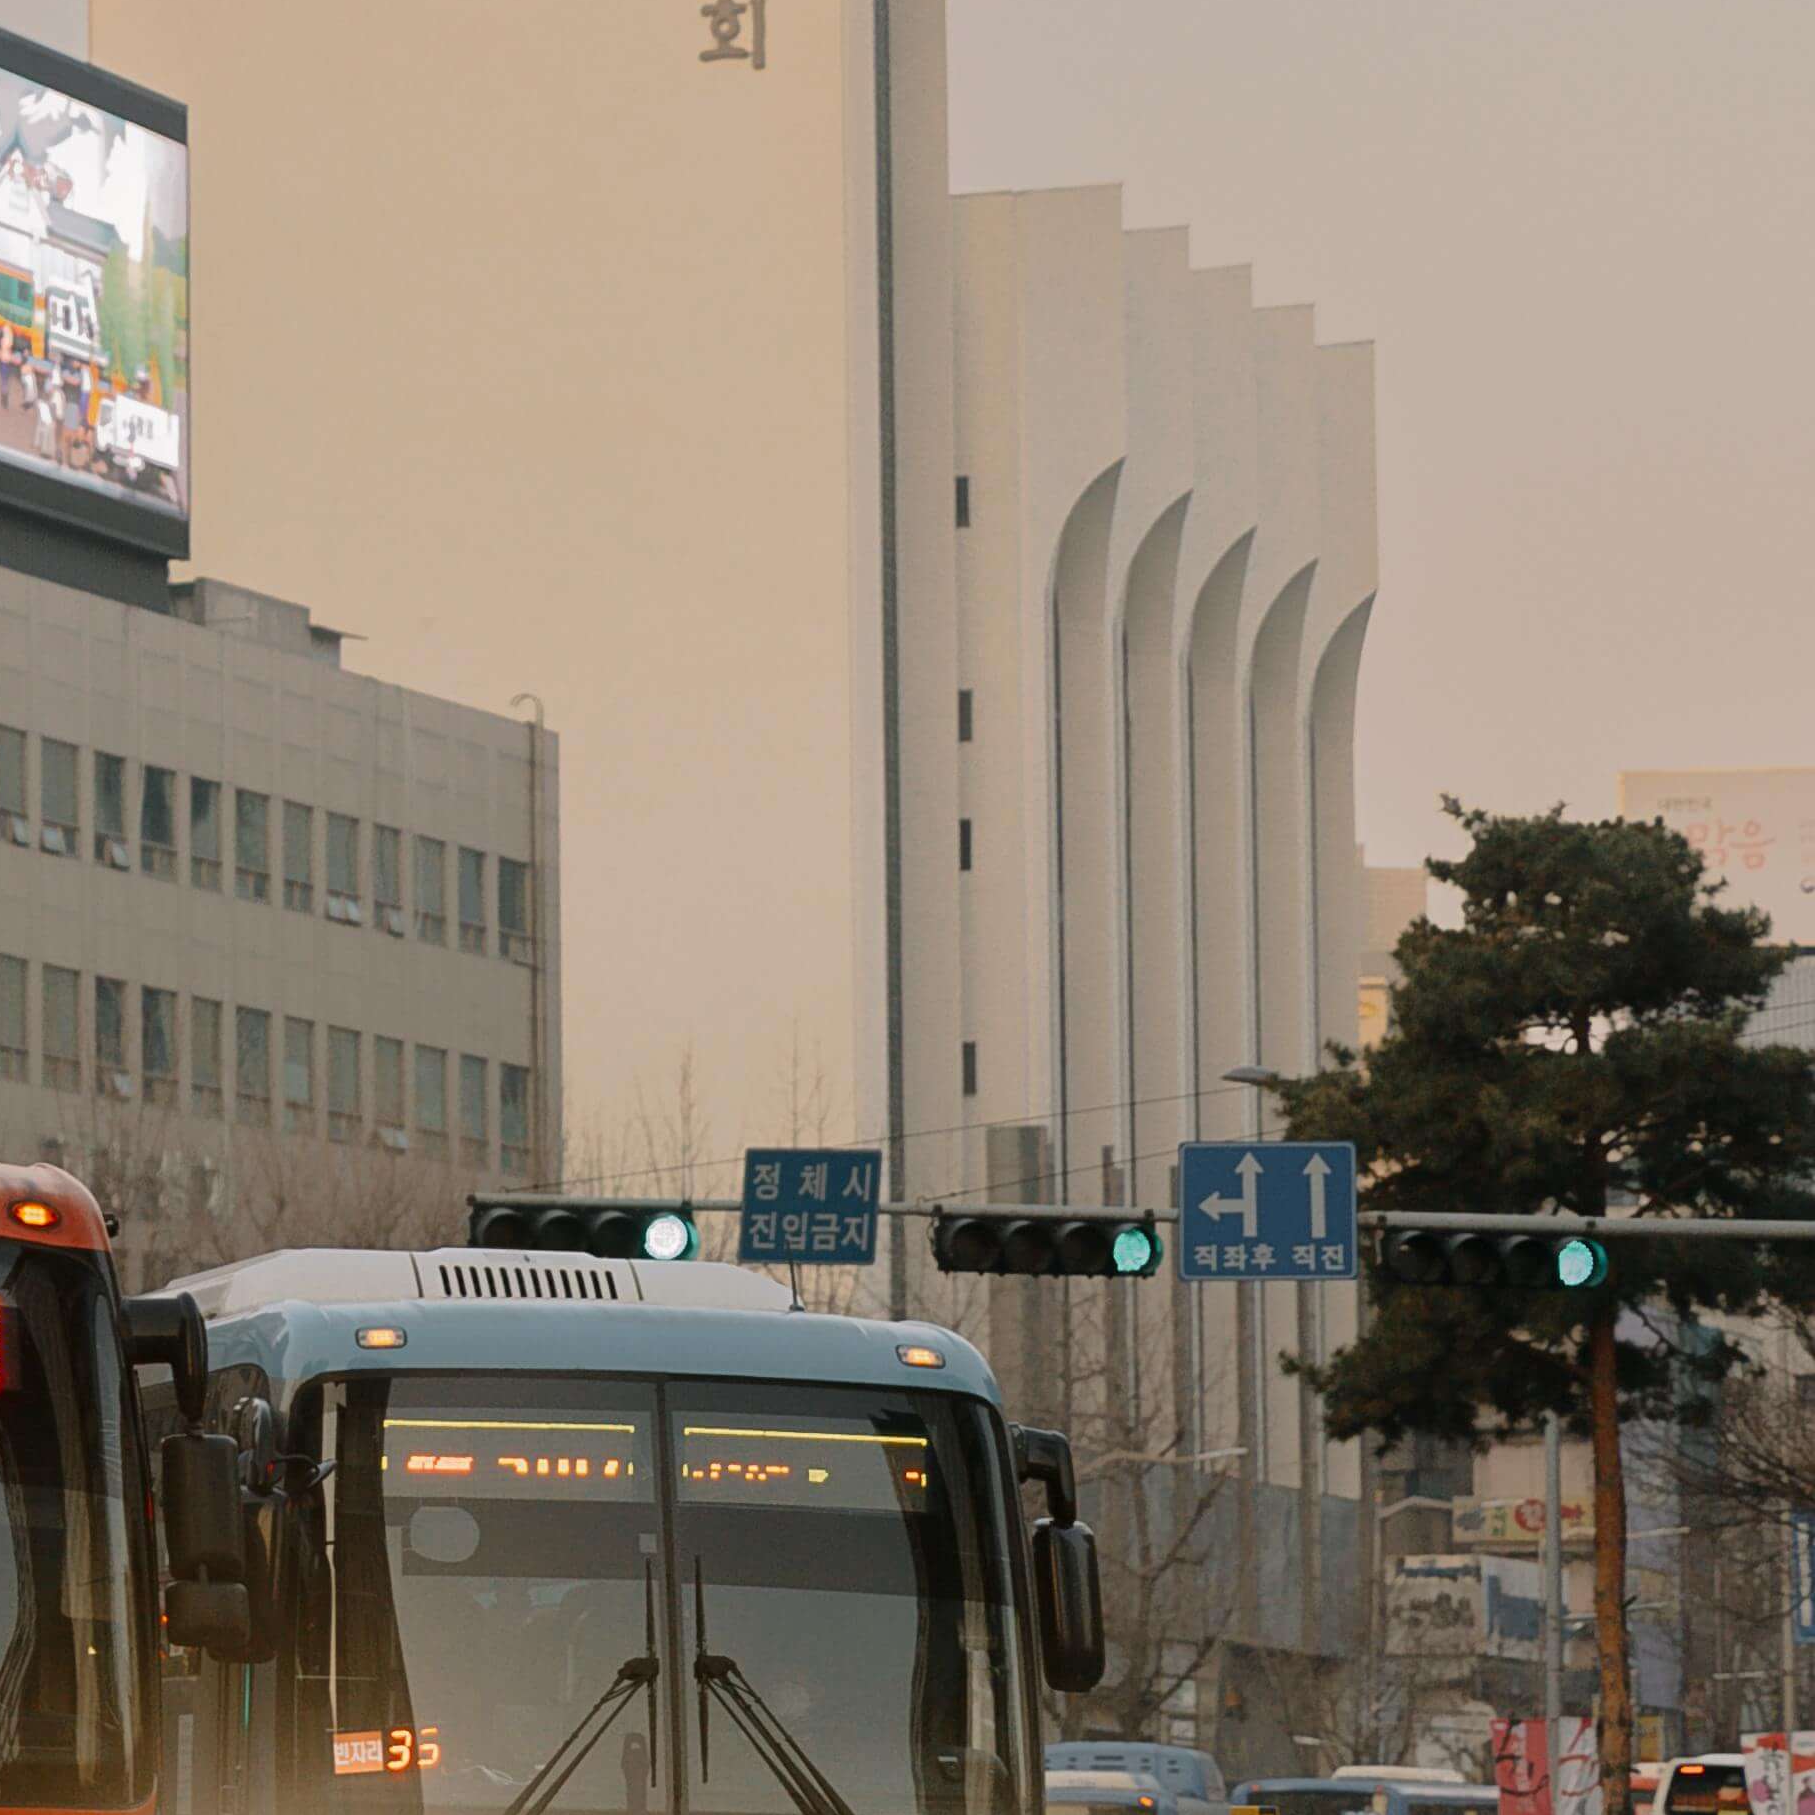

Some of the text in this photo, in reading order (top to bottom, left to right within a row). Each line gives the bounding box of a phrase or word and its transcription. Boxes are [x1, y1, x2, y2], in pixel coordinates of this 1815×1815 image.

[749, 1210, 872, 1252] 진입금지
[1194, 1243, 1345, 1272] 직좌후 직진
